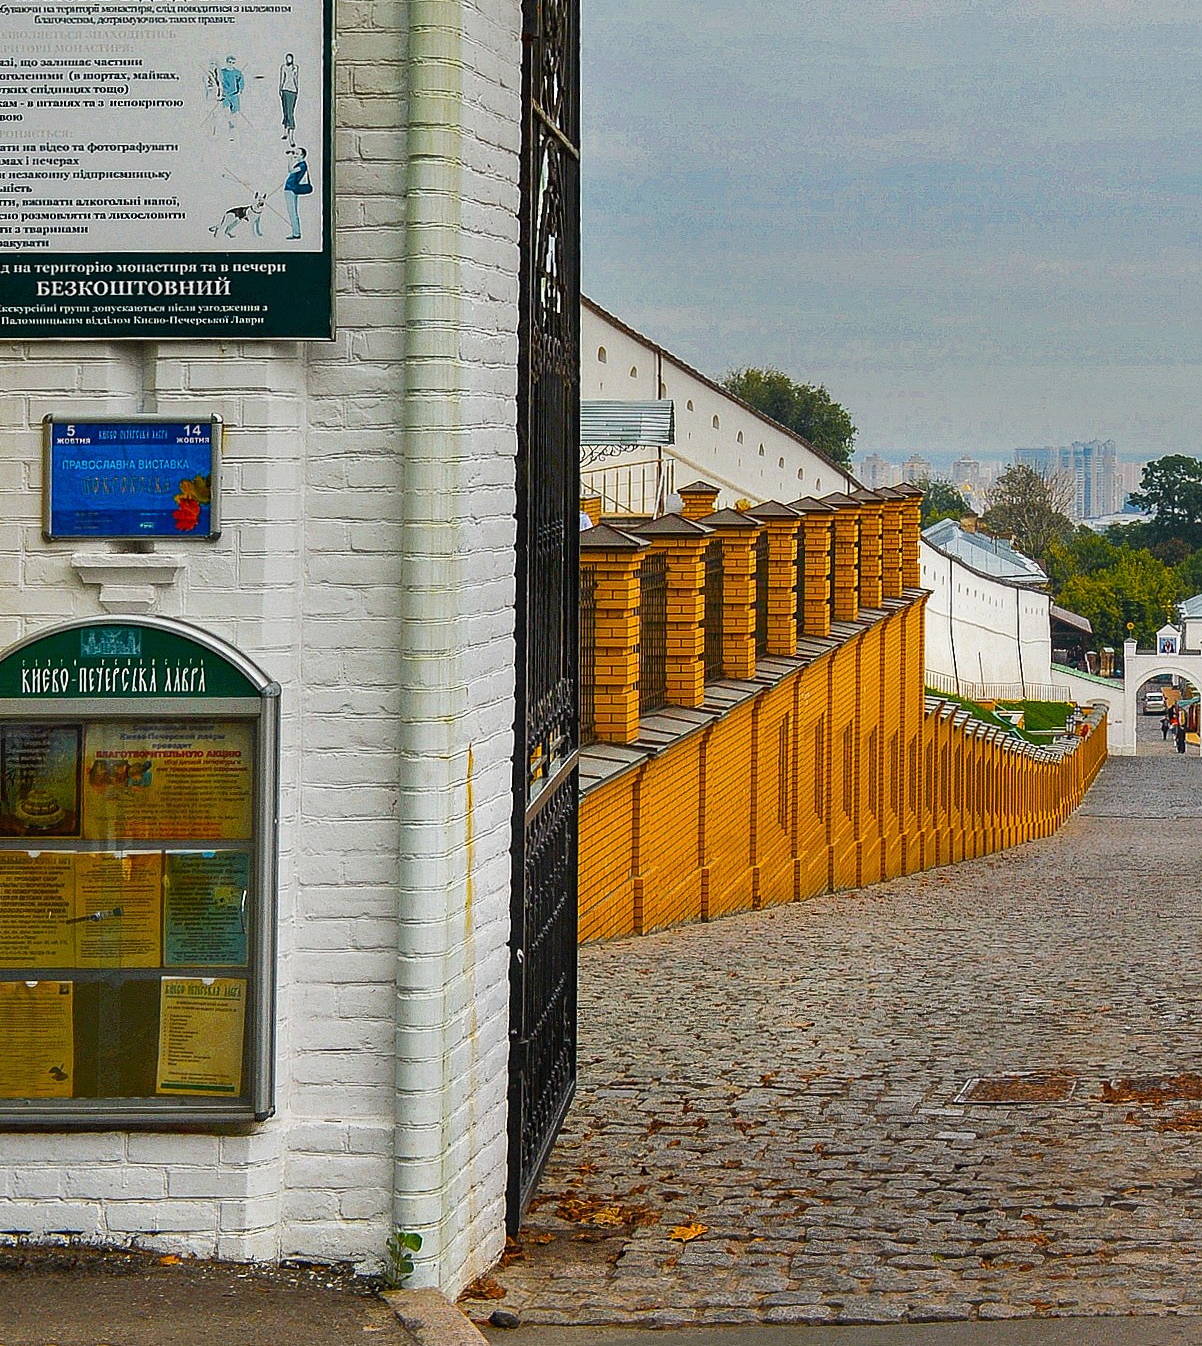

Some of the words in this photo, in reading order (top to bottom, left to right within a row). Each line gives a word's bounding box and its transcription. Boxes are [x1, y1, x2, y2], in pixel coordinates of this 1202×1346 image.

[20, 60, 38, 70] що
[93, 84, 129, 95] тощо)
[40, 142, 70, 153] відео
[87, 142, 179, 154] фотографувати
[32, 158, 79, 167] печерах
[8, 172, 70, 181] незаконну
[22, 199, 73, 207] вживати
[75, 196, 141, 206] алкогольні
[21, 212, 91, 222] розмовляти
[24, 226, 88, 235] тваринами
[13, 264, 31, 273] на
[34, 261, 113, 276] територію
[116, 264, 197, 275] монастиря
[200, 264, 217, 273] та
[220, 264, 229, 272] в
[232, 263, 287, 275] печери
[36, 276, 232, 296] БЕЗКОШТОВНИЙ
[231, 316, 265, 326] Лаври
[67, 424, 76, 437] 5
[184, 424, 202, 437] 14
[62, 459, 136, 470] ПРАВОСЛАВНА
[138, 459, 190, 470] ВИСТАВКА
